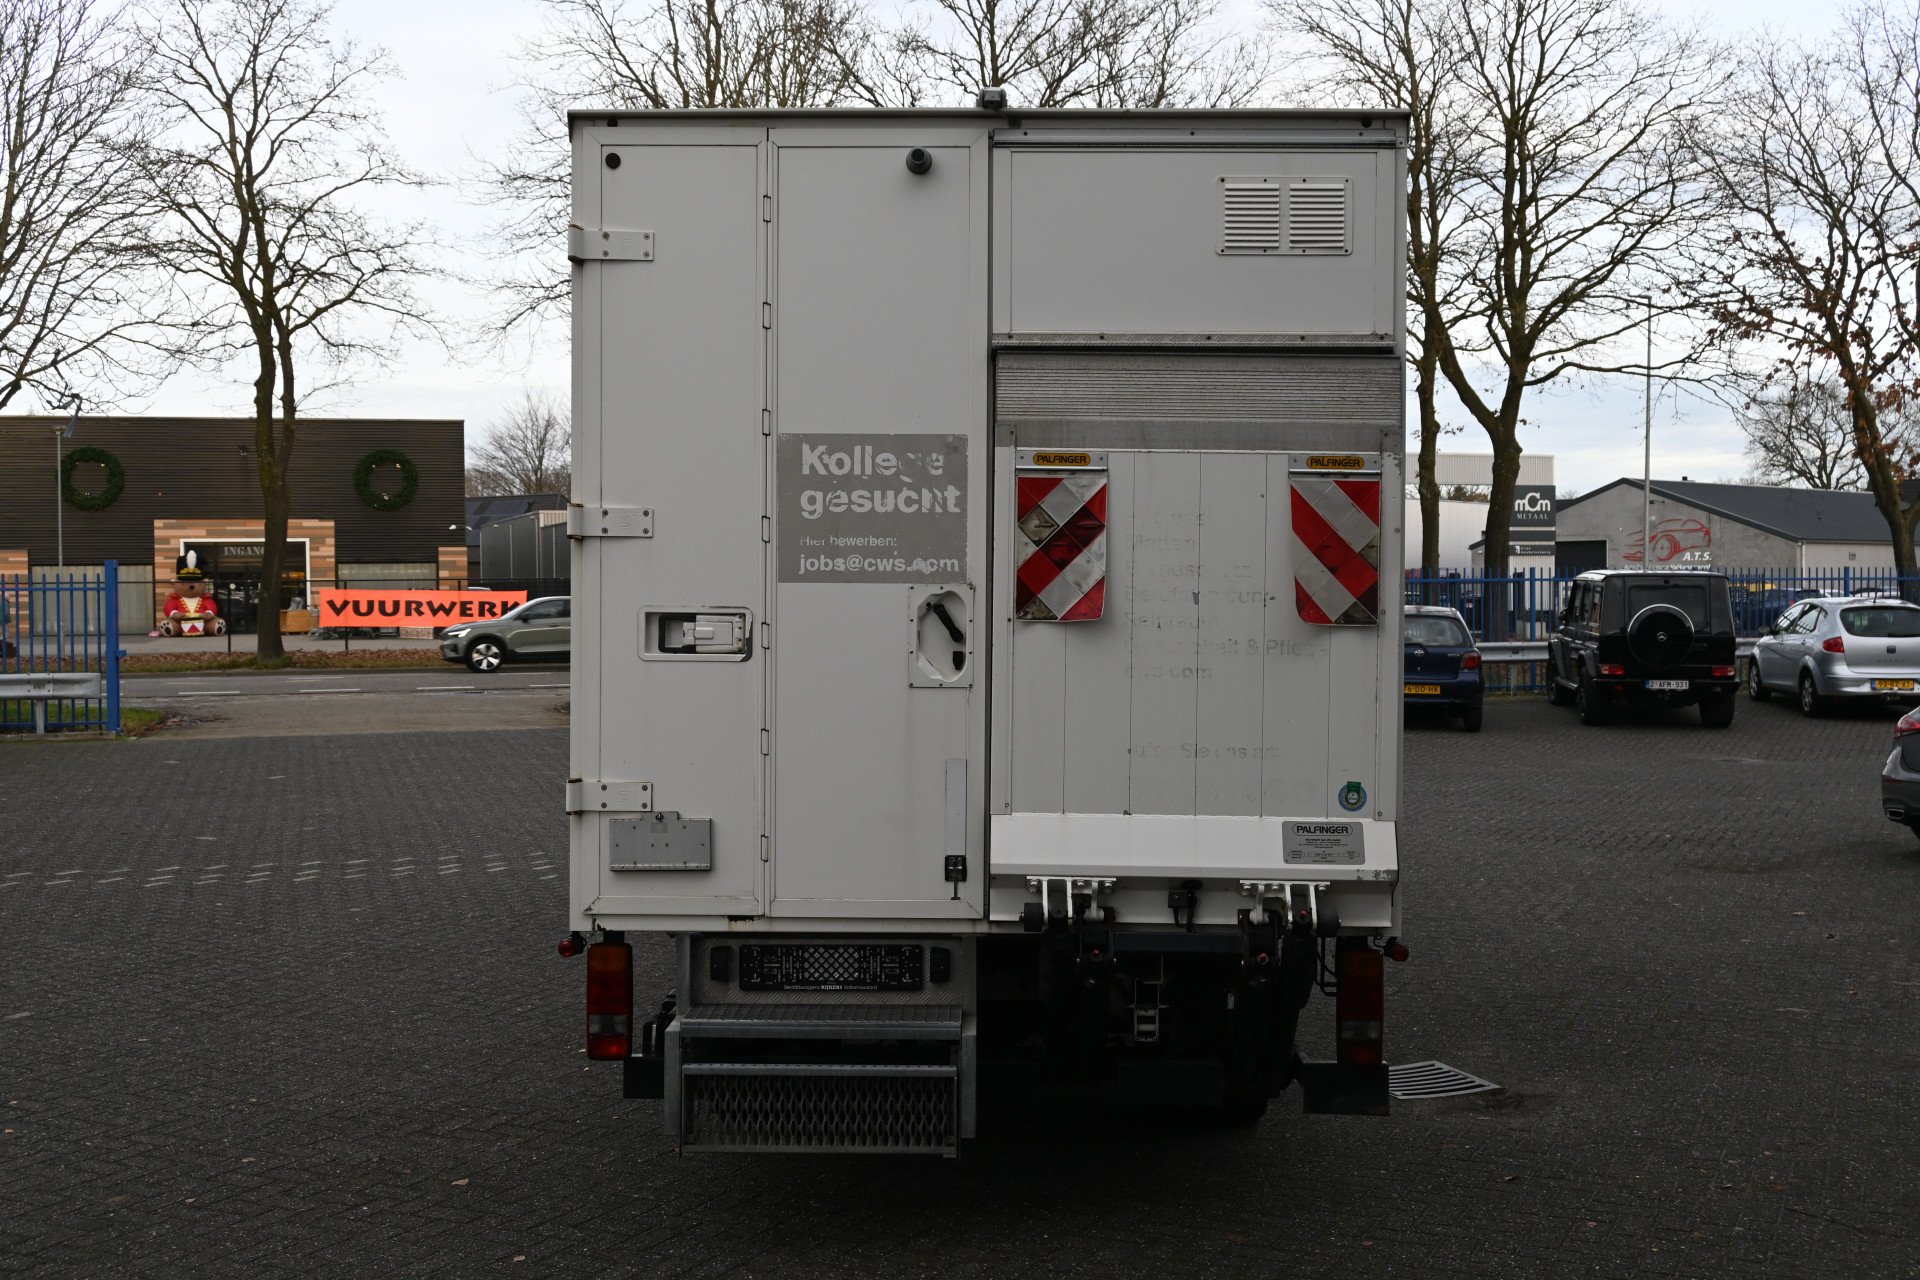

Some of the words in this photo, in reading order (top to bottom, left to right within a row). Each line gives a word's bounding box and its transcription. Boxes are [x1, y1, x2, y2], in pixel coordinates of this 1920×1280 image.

[1036, 453, 1087, 465] PALFINGER
[1310, 457, 1360, 468] PALFINGER
[1682, 551, 1712, 561] A.T.S.
[1296, 825, 1349, 834] PALFINGER
